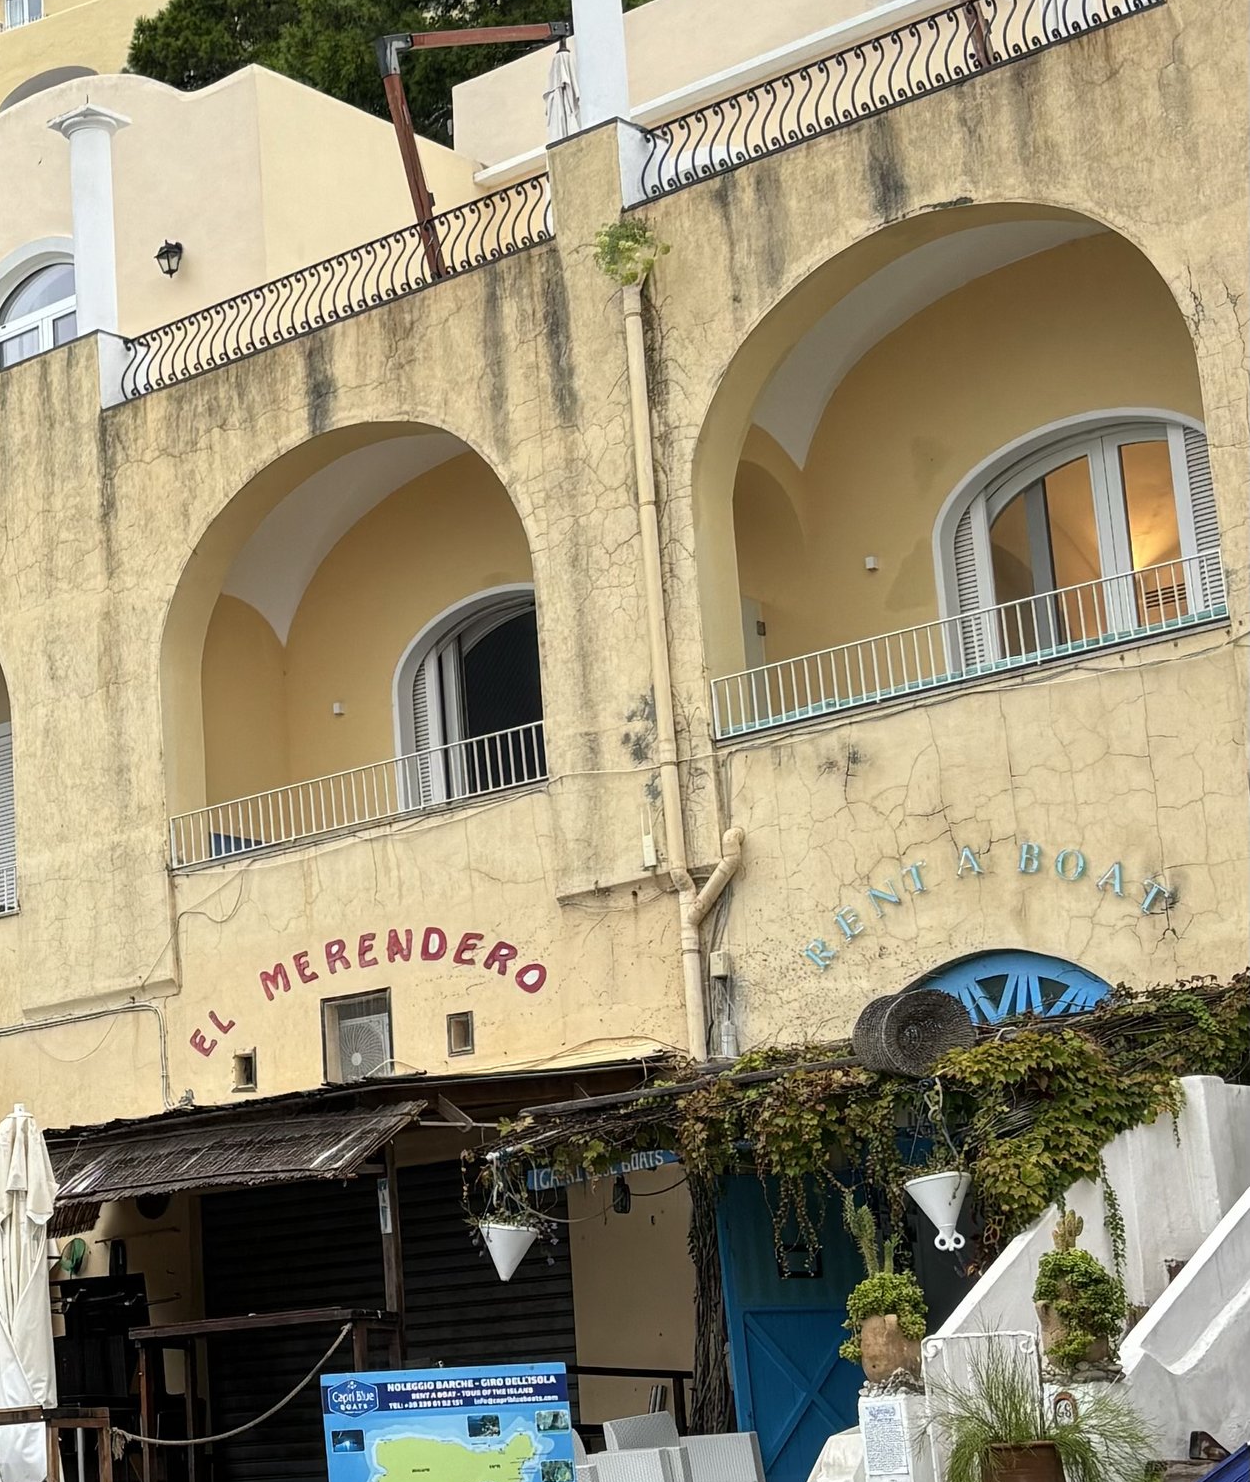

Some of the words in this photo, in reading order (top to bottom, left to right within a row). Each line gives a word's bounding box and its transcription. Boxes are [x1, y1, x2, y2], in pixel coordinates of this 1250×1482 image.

[803, 860, 927, 972] RENT
[956, 846, 985, 878] A
[1017, 841, 1171, 916] BOAT
[189, 1009, 235, 1057] EL
[259, 927, 547, 1001] MERENDERO
[387, 1381, 434, 1392] NOLEGGIO
[436, 1379, 474, 1389] BARCHE
[481, 1377, 503, 1387] GIRO
[507, 1387, 534, 1395] ISLAND
[332, 1390, 355, 1404] Capri
[356, 1390, 375, 1402] Blue
[340, 1403, 368, 1411] BOATS
